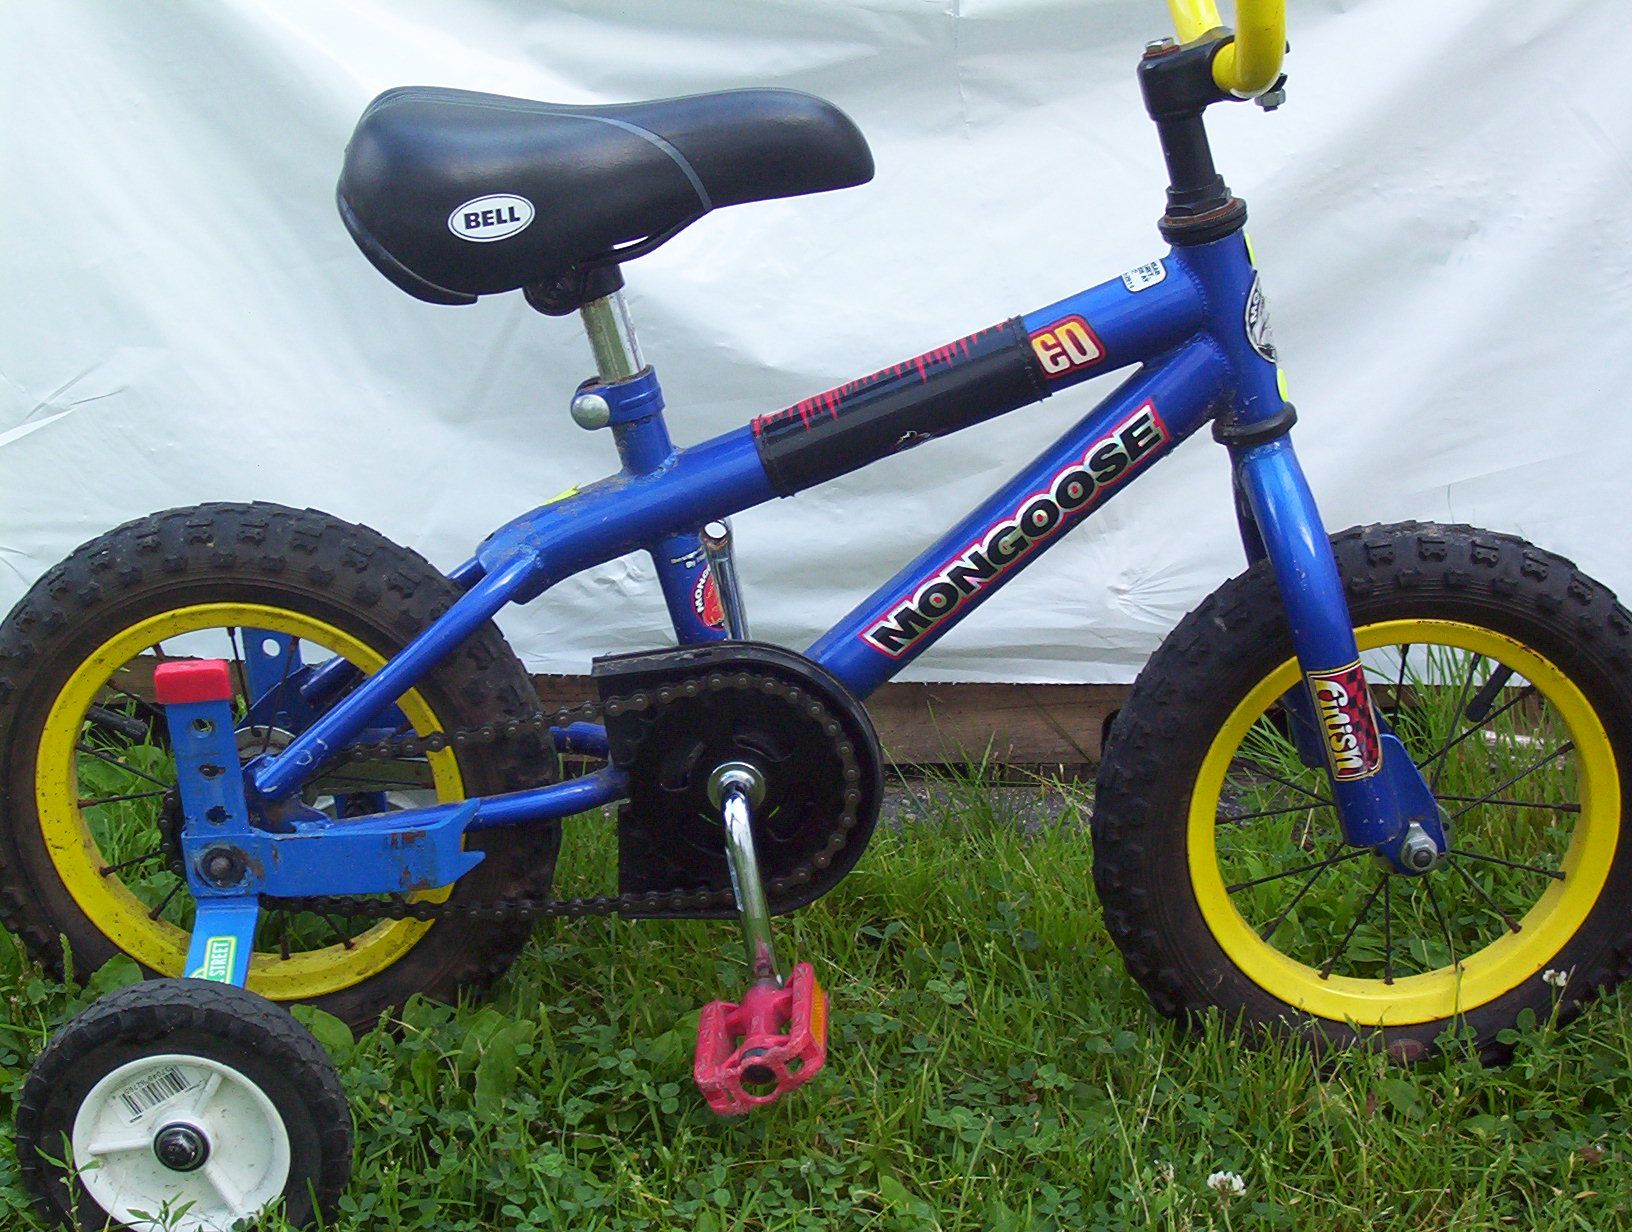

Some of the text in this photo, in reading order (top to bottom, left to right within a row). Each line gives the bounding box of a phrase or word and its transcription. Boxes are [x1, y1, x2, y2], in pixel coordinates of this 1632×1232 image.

[464, 206, 521, 230] BELL
[868, 408, 1165, 654] MONGOOSE
[208, 942, 230, 977] STREET
